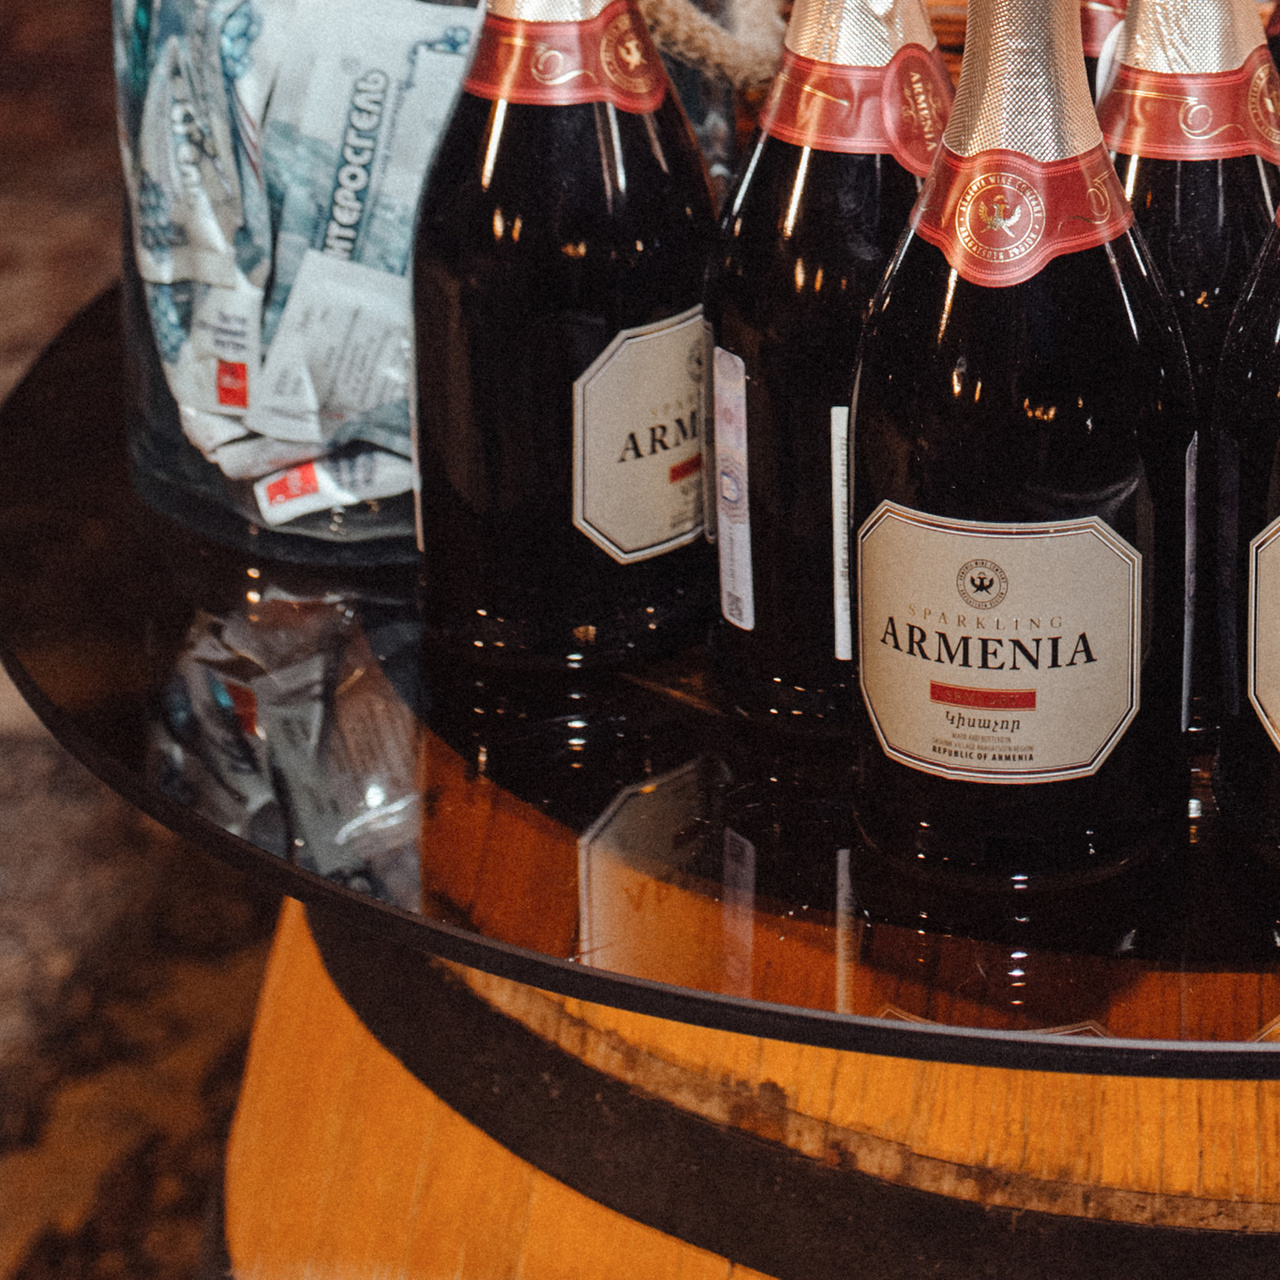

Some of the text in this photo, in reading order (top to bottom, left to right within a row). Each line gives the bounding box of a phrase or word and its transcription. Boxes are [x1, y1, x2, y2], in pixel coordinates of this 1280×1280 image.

[909, 71, 938, 152] ARMENIA
[322, 67, 390, 261] НТЕРОСГЕЛЬ
[958, 175, 1044, 216] ARMENIA WINE COMPANY
[617, 410, 700, 464] ARM
[908, 604, 1064, 630] SPARKLING
[880, 616, 1098, 670] ARMENIA
[946, 711, 1020, 732] Կիսաչոր
[932, 746, 974, 760] REPUBLIC
[992, 754, 1034, 762] ARMENIA
